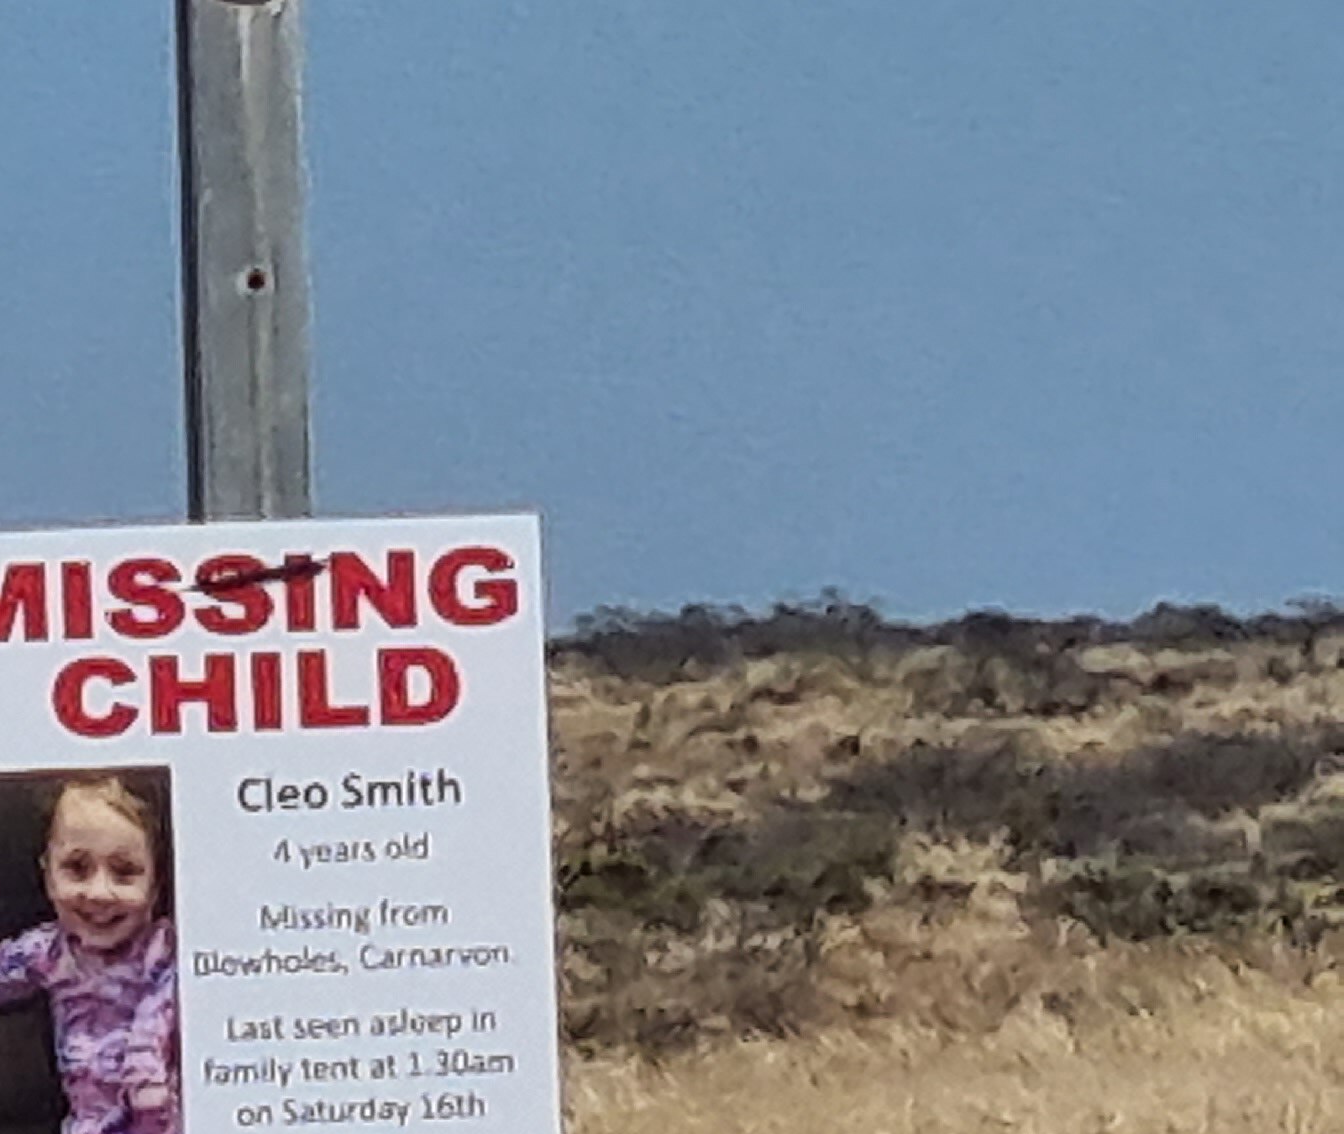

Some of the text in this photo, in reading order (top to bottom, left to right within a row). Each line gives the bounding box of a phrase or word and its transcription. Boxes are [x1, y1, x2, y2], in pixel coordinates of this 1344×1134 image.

[52, 646, 460, 738] CHILD
[236, 767, 462, 813] Cleo Smith
[273, 831, 429, 870] 4 years old
[260, 898, 449, 936] Missing from
[226, 1007, 497, 1043] Last seen asleep in
[203, 1057, 293, 1089] family
[300, 1056, 361, 1082] tent
[370, 1054, 398, 1080] at
[236, 1091, 486, 1128] on Saturday 16th
